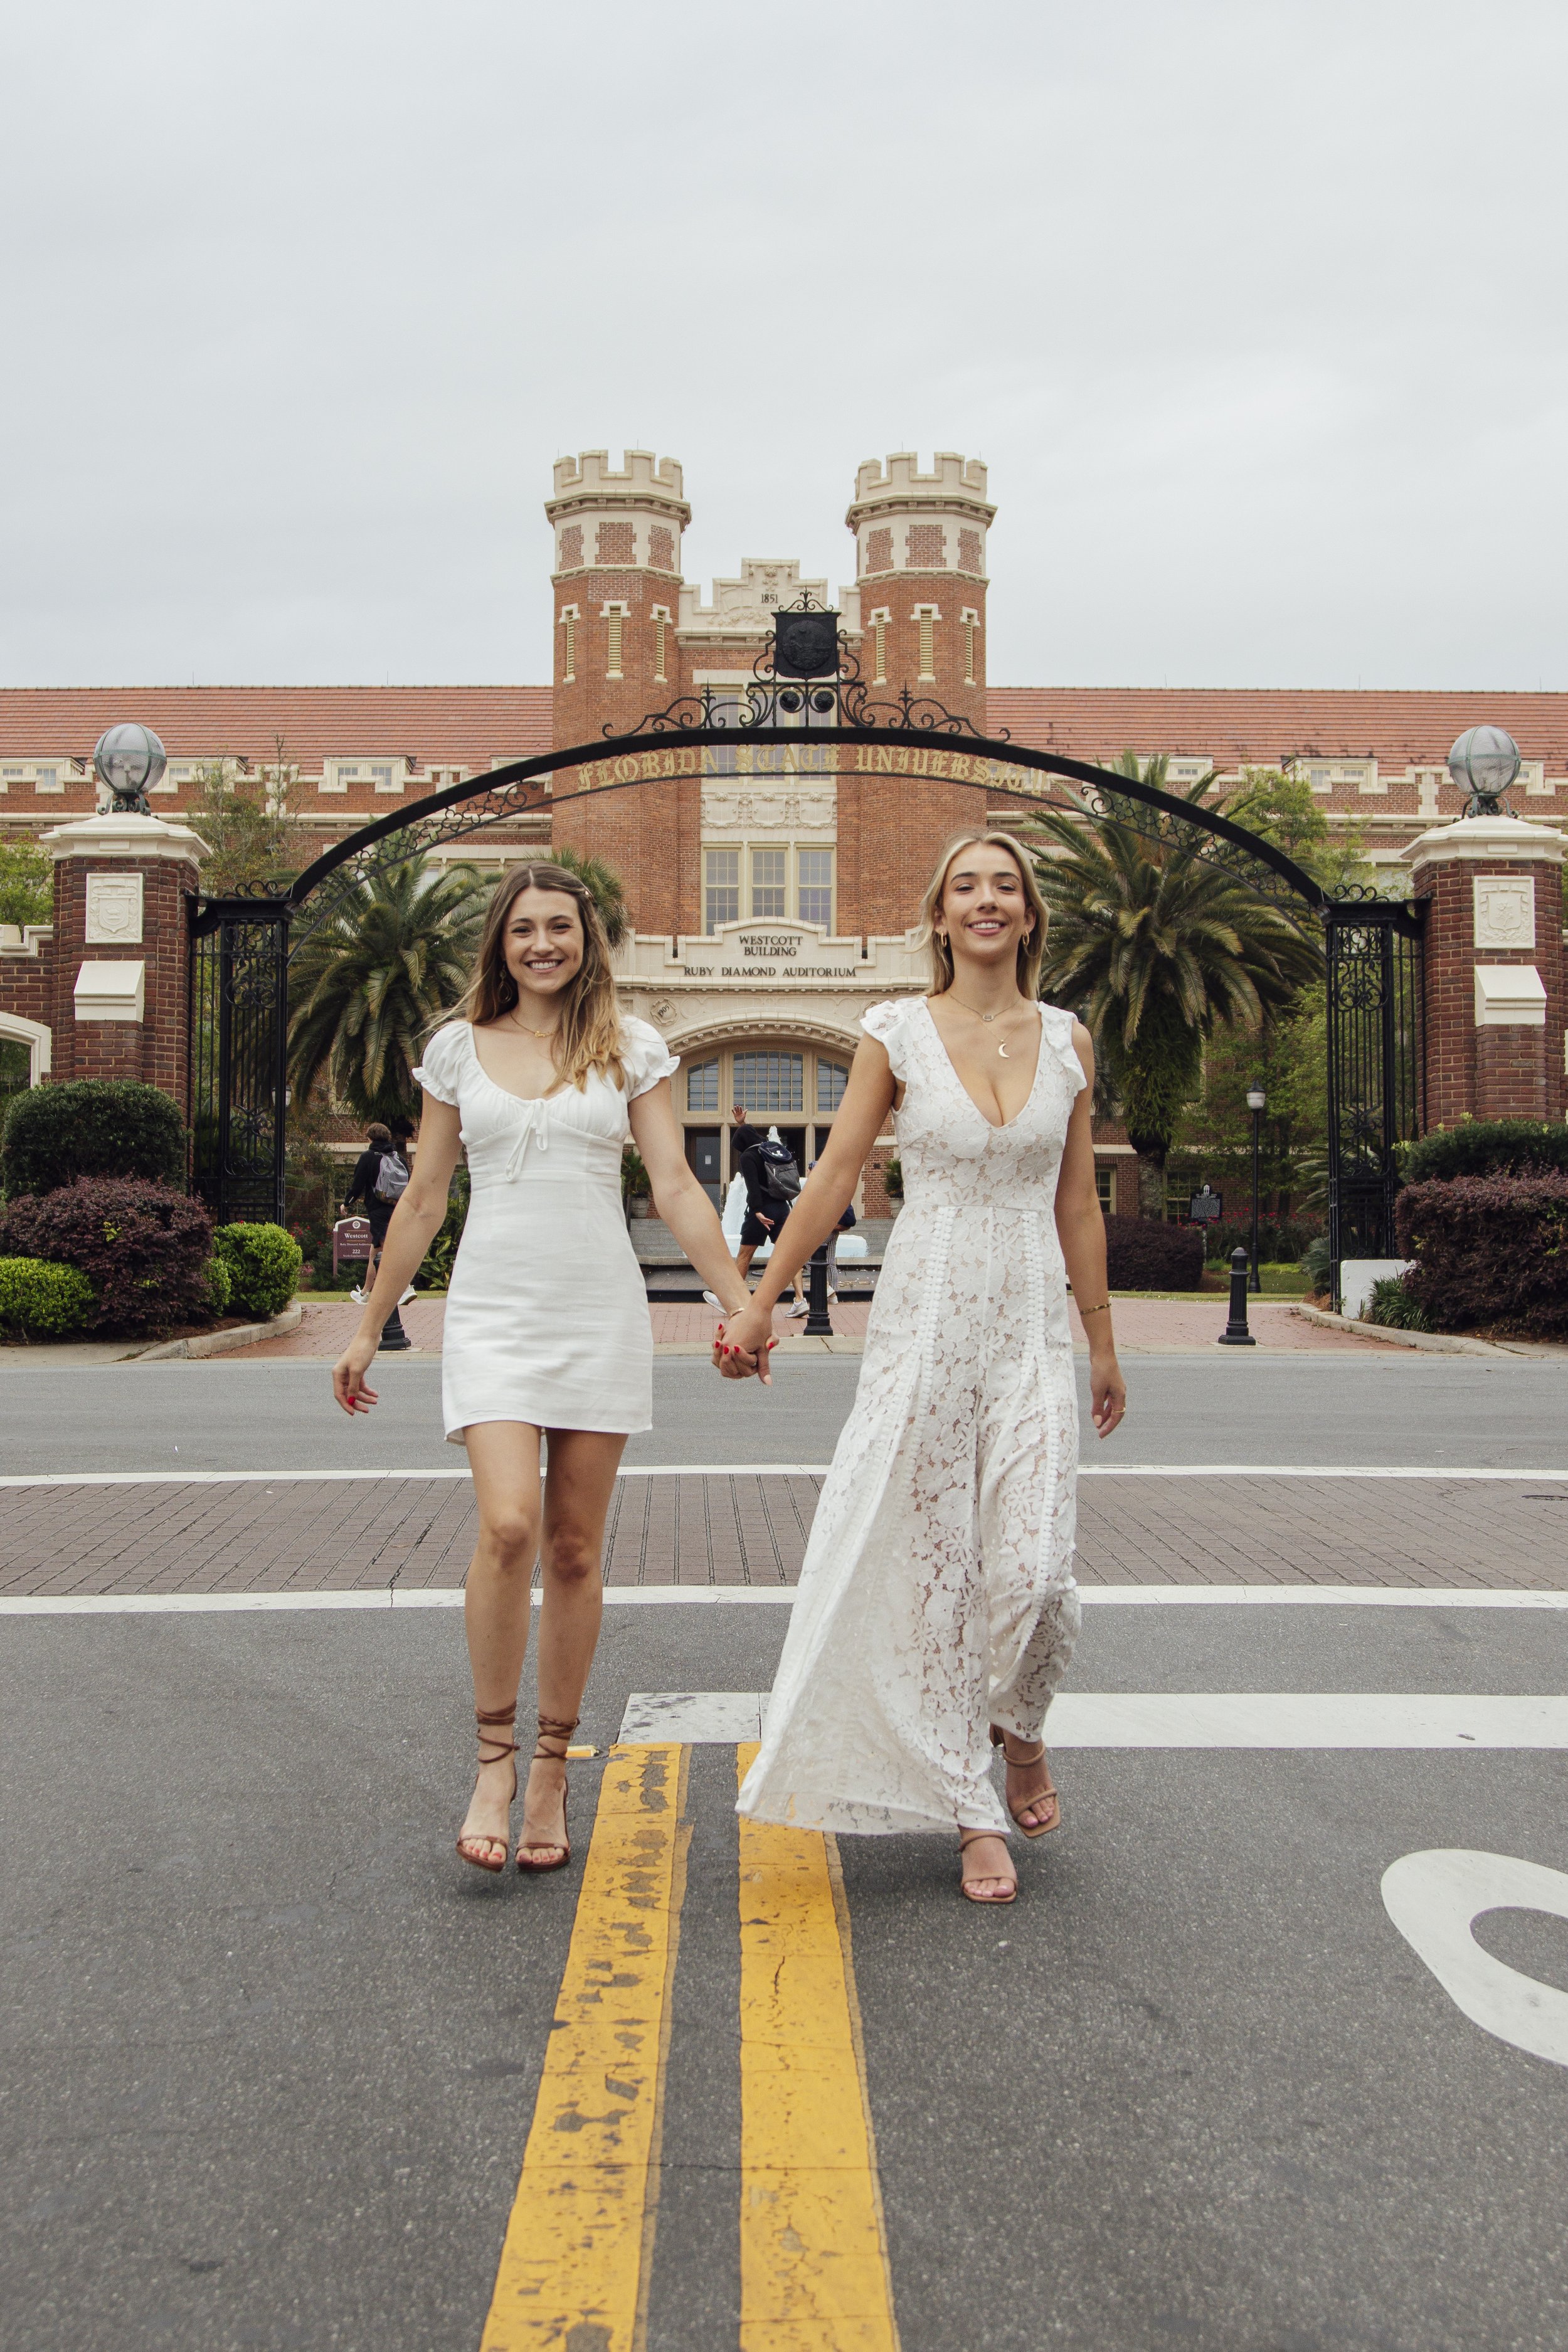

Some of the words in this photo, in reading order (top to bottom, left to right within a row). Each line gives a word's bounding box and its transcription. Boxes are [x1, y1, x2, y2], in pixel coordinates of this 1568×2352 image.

[761, 593, 778, 603] 1851
[575, 745, 719, 792] FLORIDA
[735, 744, 840, 772] STATE
[854, 745, 1048, 797] UNIVERSITY
[739, 935, 803, 945] WESTCOTT
[744, 946, 797, 956] BUILDING
[684, 967, 714, 976] RUBY
[721, 967, 776, 976] DIAMOND
[782, 967, 856, 977] AUDITORIUM
[658, 1004, 670, 1017] 1905
